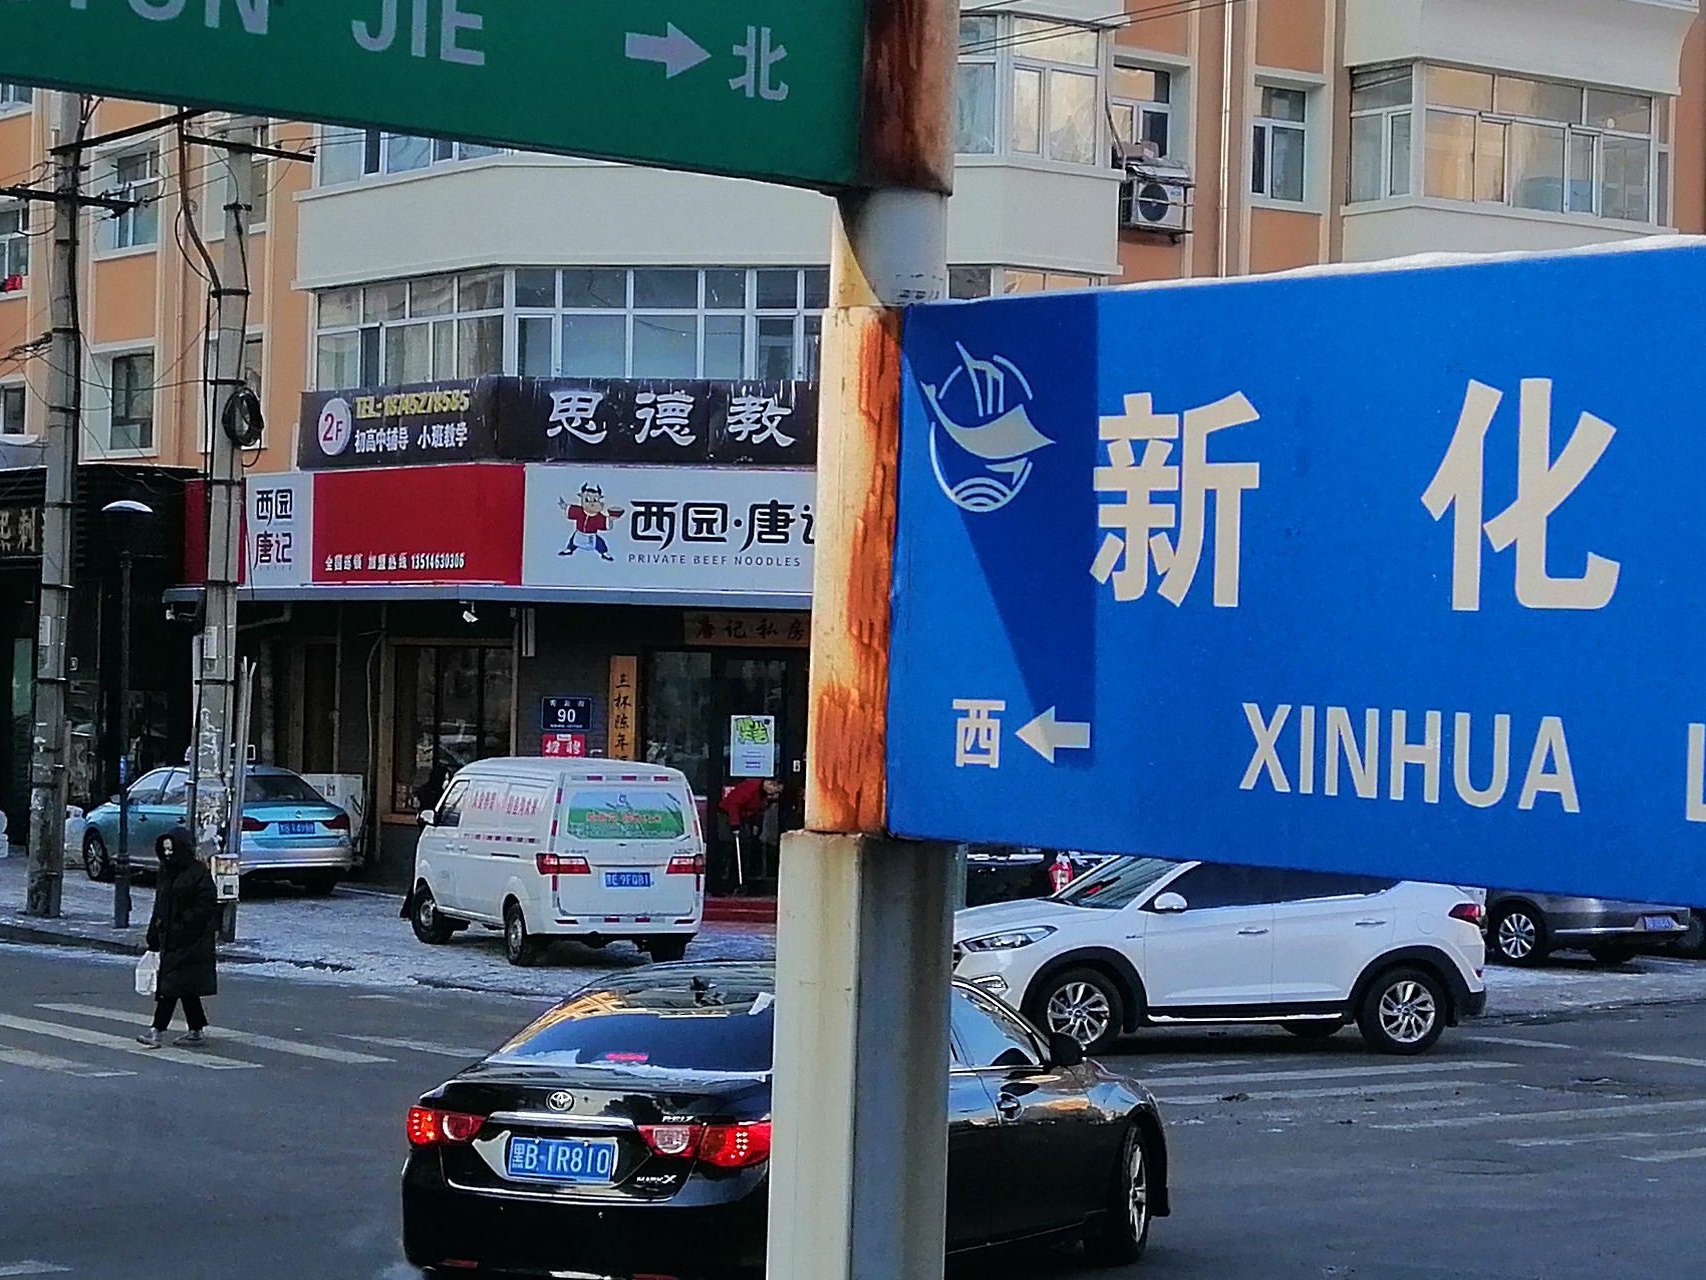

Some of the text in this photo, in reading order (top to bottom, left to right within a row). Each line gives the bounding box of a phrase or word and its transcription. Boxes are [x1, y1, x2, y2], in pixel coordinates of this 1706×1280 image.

[728, 26, 789, 101] 北
[547, 390, 795, 447] 思德教
[256, 489, 292, 526] 西园
[253, 530, 292, 570] 唐记
[628, 554, 801, 567] PRIVATE BEEF NOODLES
[695, 618, 806, 642] 唐记私房
[557, 709, 576, 723] 90
[614, 673, 631, 761] 三杯陈年
[952, 699, 1006, 769] 西
[1240, 702, 1580, 813] XINHUA
